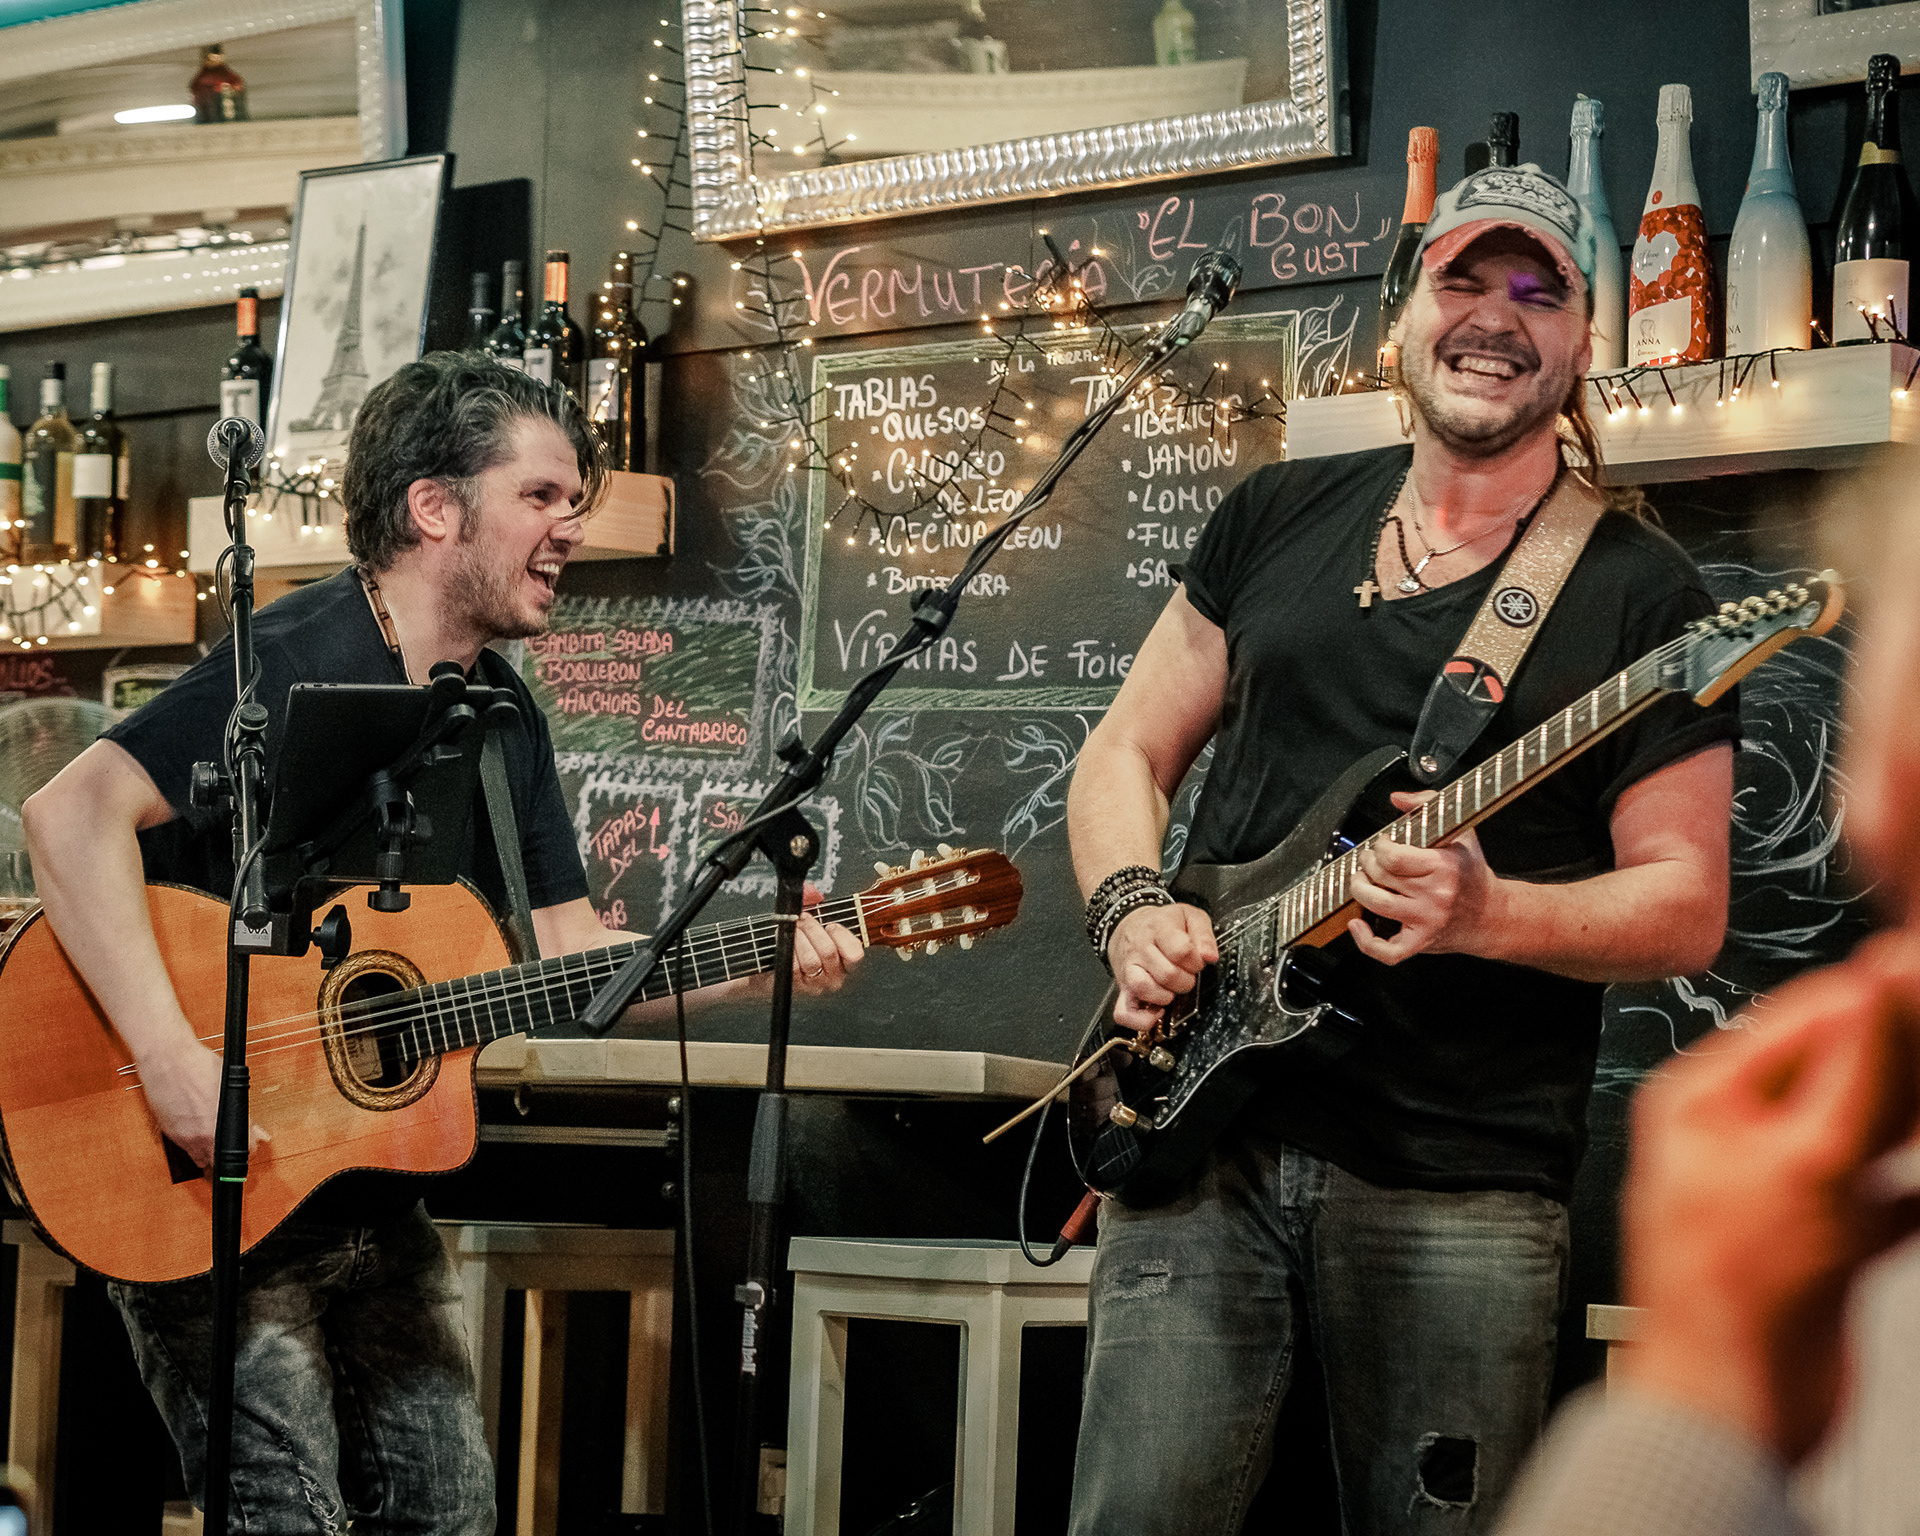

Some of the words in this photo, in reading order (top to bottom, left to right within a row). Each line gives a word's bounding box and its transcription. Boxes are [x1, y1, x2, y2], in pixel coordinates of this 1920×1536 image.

[1250, 187, 1361, 247] BON
[1636, 338, 1661, 347] ANNA
[1018, 354, 1036, 373] LA
[833, 374, 938, 422] TABLAS
[882, 406, 986, 443] QUESOS
[886, 447, 1006, 494] CHORIZO
[1137, 438, 1238, 480] JAMON
[1142, 483, 1224, 515] LOMO
[1136, 522, 1208, 551] FUE
[882, 566, 1011, 598] BUTIFRRA
[613, 629, 674, 655] SALADA
[542, 656, 642, 685] BOQUERON
[996, 640, 1049, 682] DE
[563, 687, 642, 716] ANCHOAS
[650, 694, 688, 719] DEL
[641, 718, 748, 746] CANTABRICO
[590, 803, 647, 861] TAPAS
[603, 837, 643, 900] DEL
